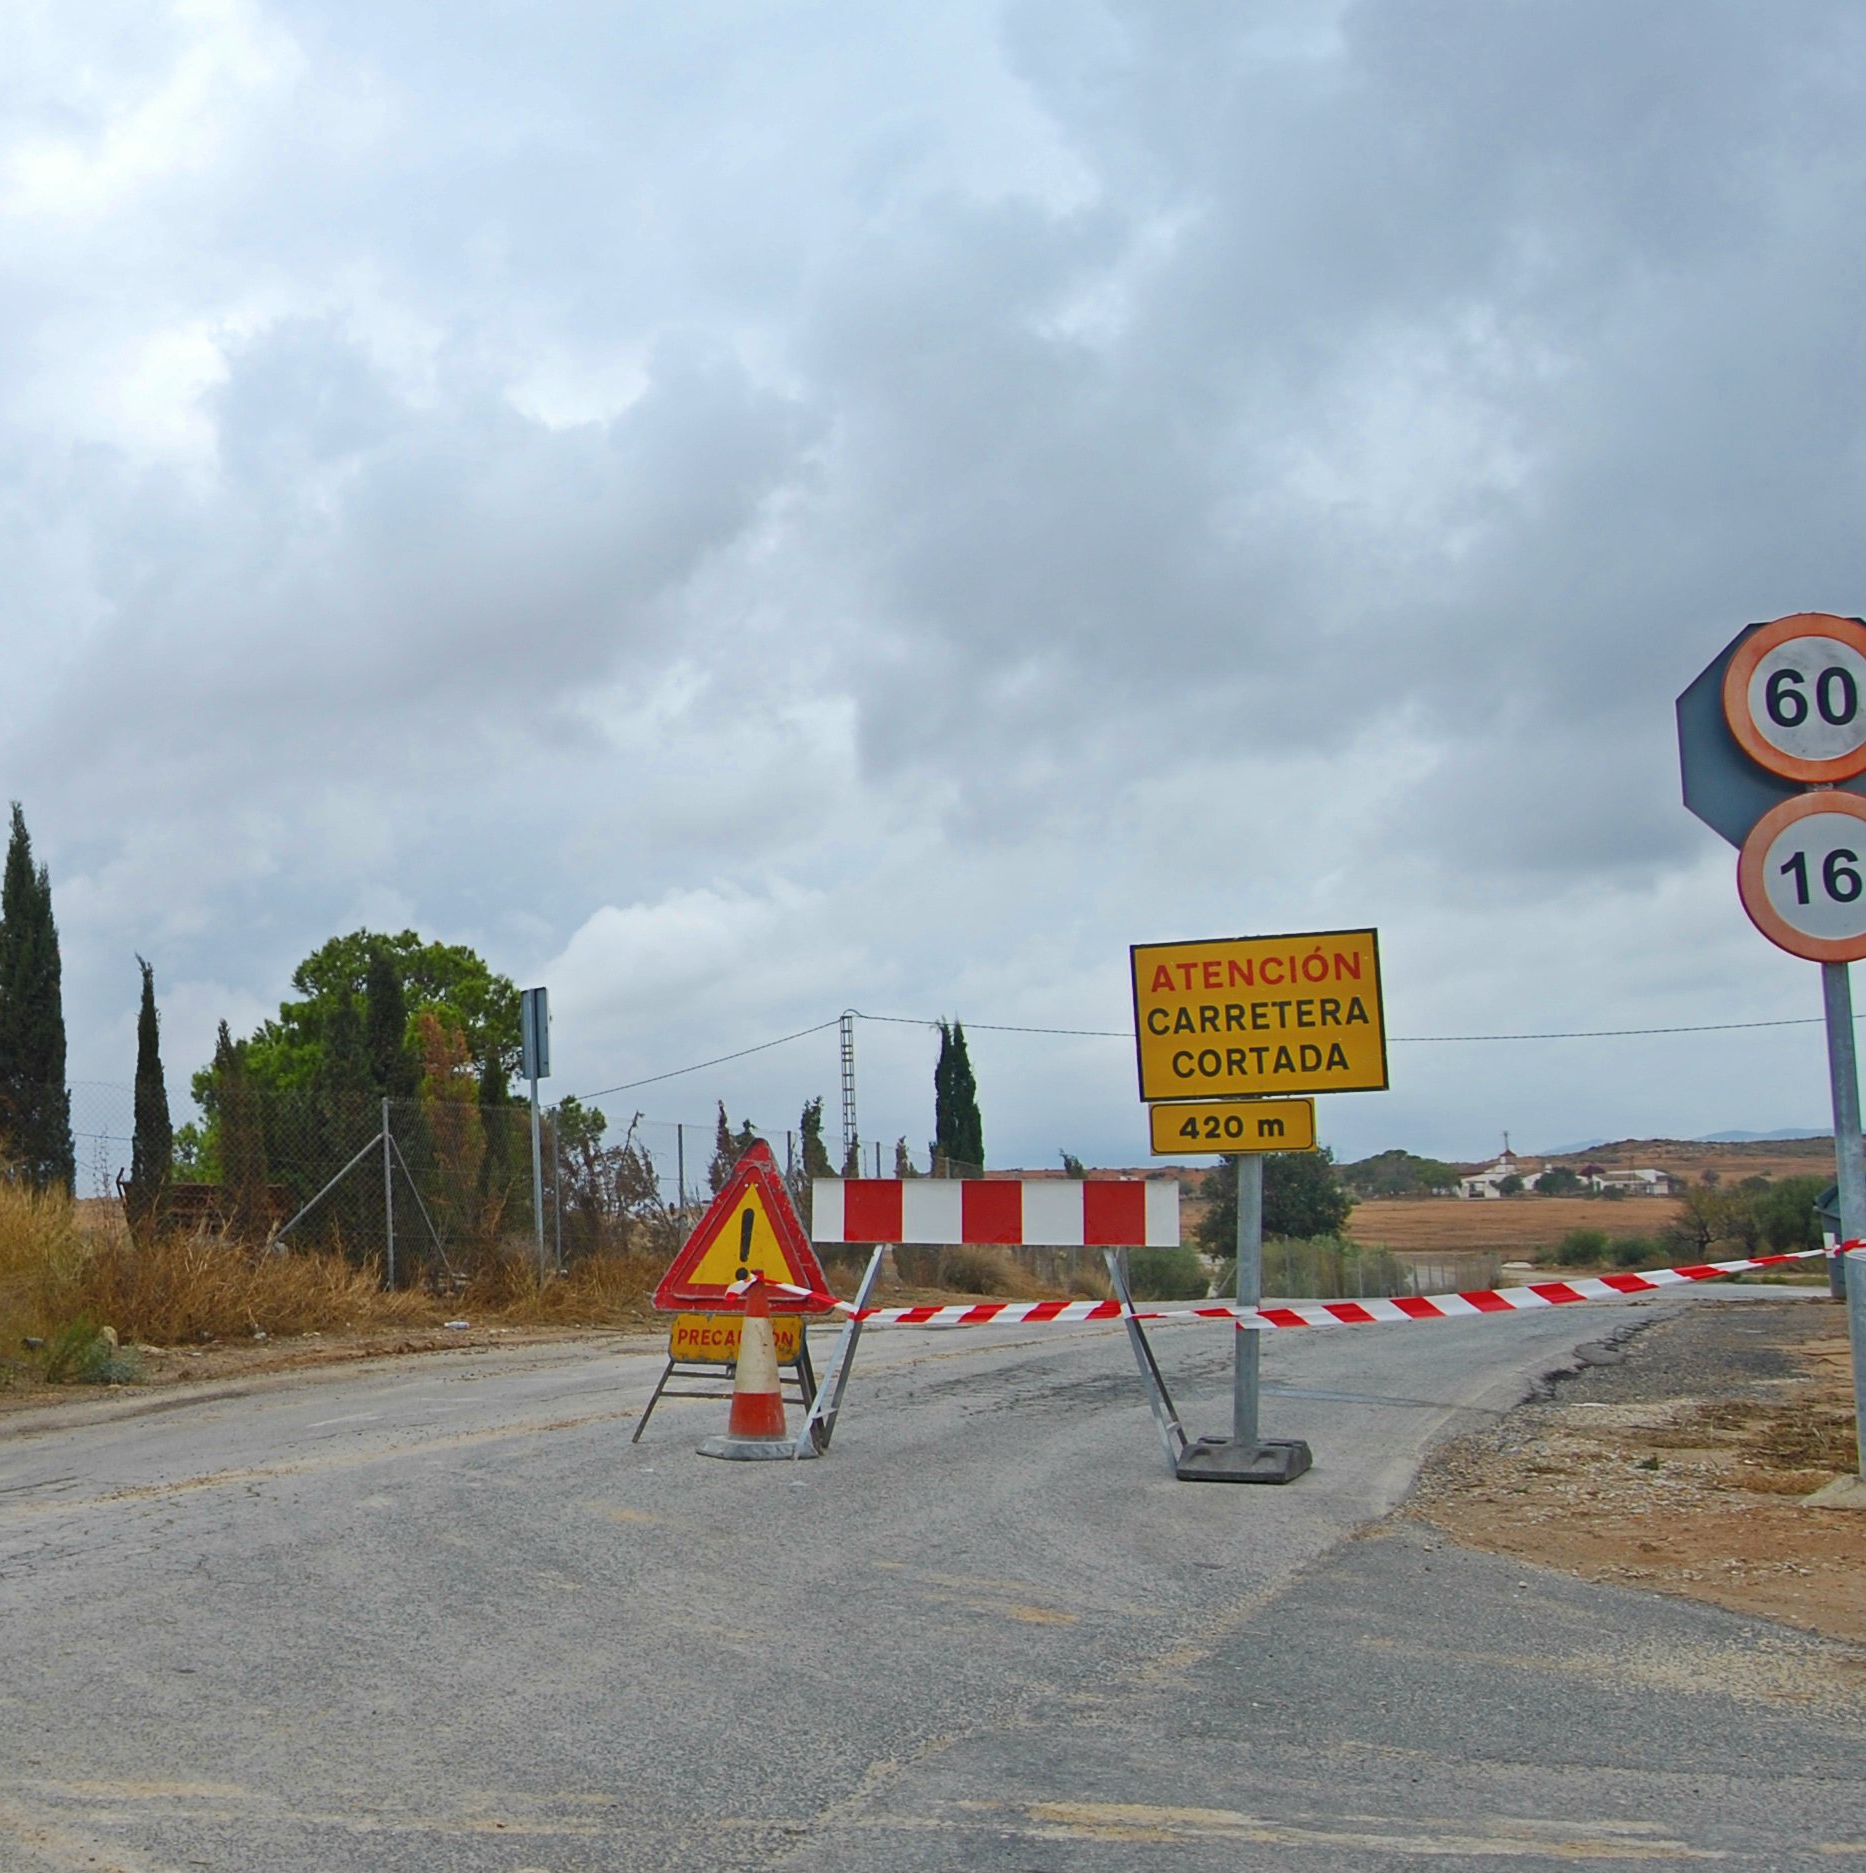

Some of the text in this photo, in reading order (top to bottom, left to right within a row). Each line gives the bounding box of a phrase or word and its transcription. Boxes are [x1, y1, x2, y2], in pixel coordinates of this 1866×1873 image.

[1765, 667, 1858, 728] 60
[1780, 848, 1863, 905] 16
[1151, 946, 1361, 993] ATENCIÓN
[1147, 996, 1370, 1036] CARRETERA
[1172, 1043, 1350, 1078] CORTADA
[1179, 1115, 1284, 1139] 420 m
